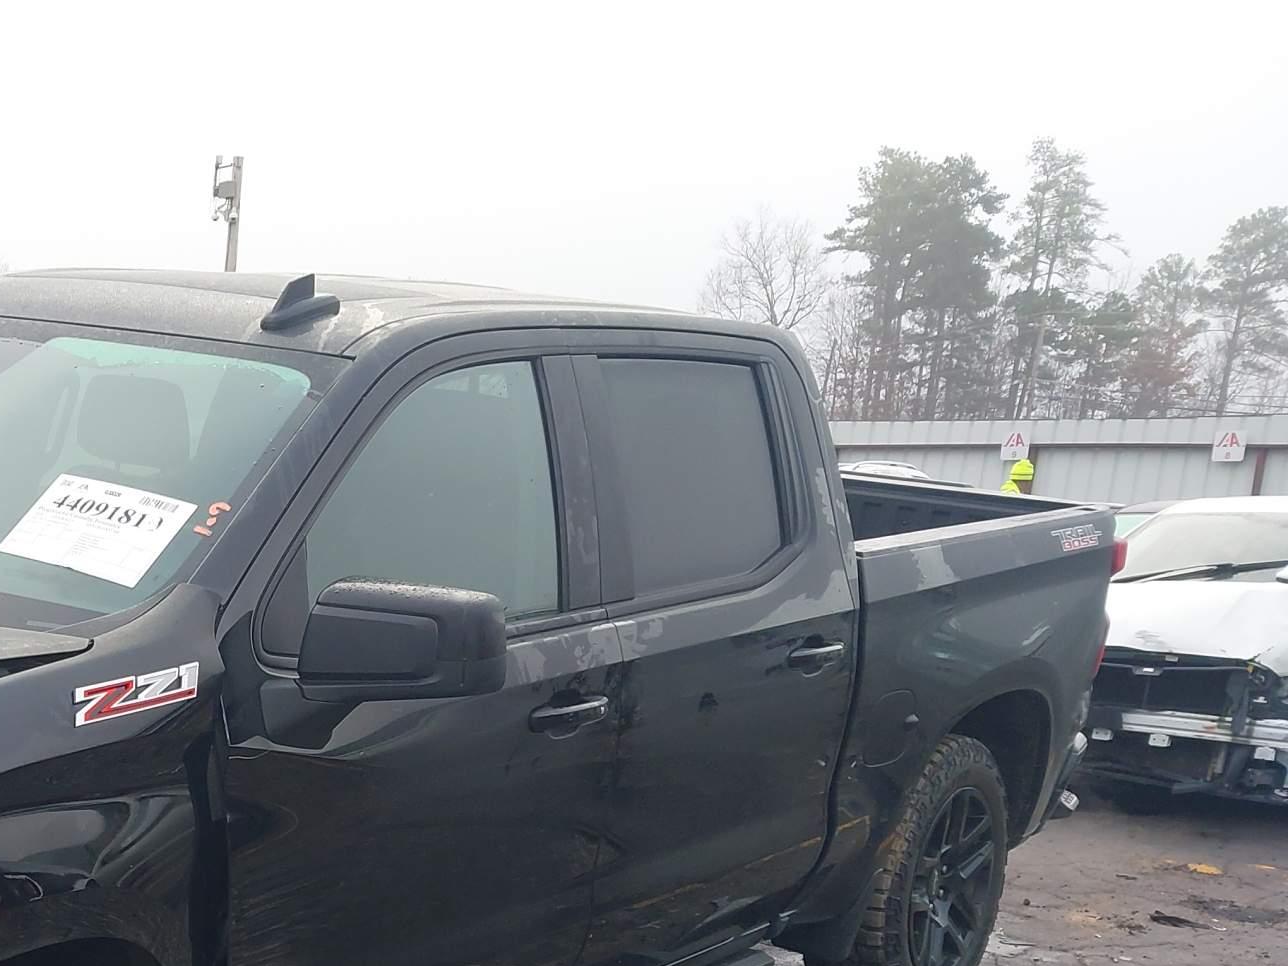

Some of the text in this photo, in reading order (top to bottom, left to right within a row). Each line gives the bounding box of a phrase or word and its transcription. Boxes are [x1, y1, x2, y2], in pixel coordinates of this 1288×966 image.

[1051, 524, 1102, 540] TRAIL
[1062, 536, 1099, 551] BOSS
[74, 661, 200, 728] Z71
